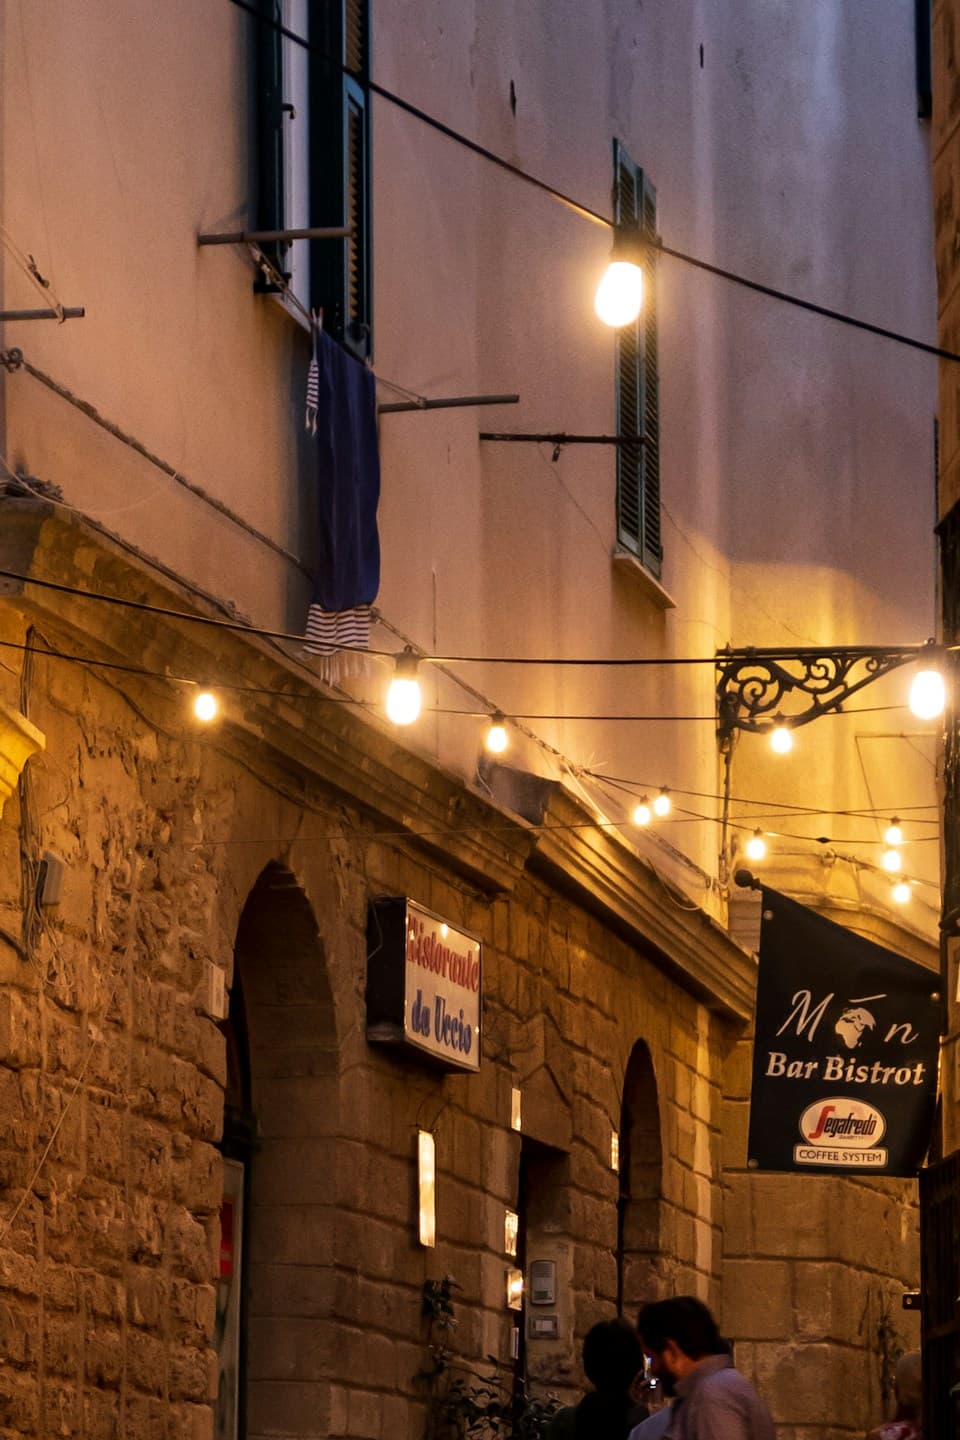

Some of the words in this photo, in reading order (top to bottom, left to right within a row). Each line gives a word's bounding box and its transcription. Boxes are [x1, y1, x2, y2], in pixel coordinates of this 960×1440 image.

[407, 913, 479, 993] Ristorante
[411, 989, 431, 1038] da
[765, 1051, 819, 1080] Bar
[822, 1055, 927, 1086] Bistrot
[808, 1105, 877, 1140] Segafredo
[799, 1149, 839, 1161] COFFEE
[842, 1152, 882, 1162] SYSTEM
